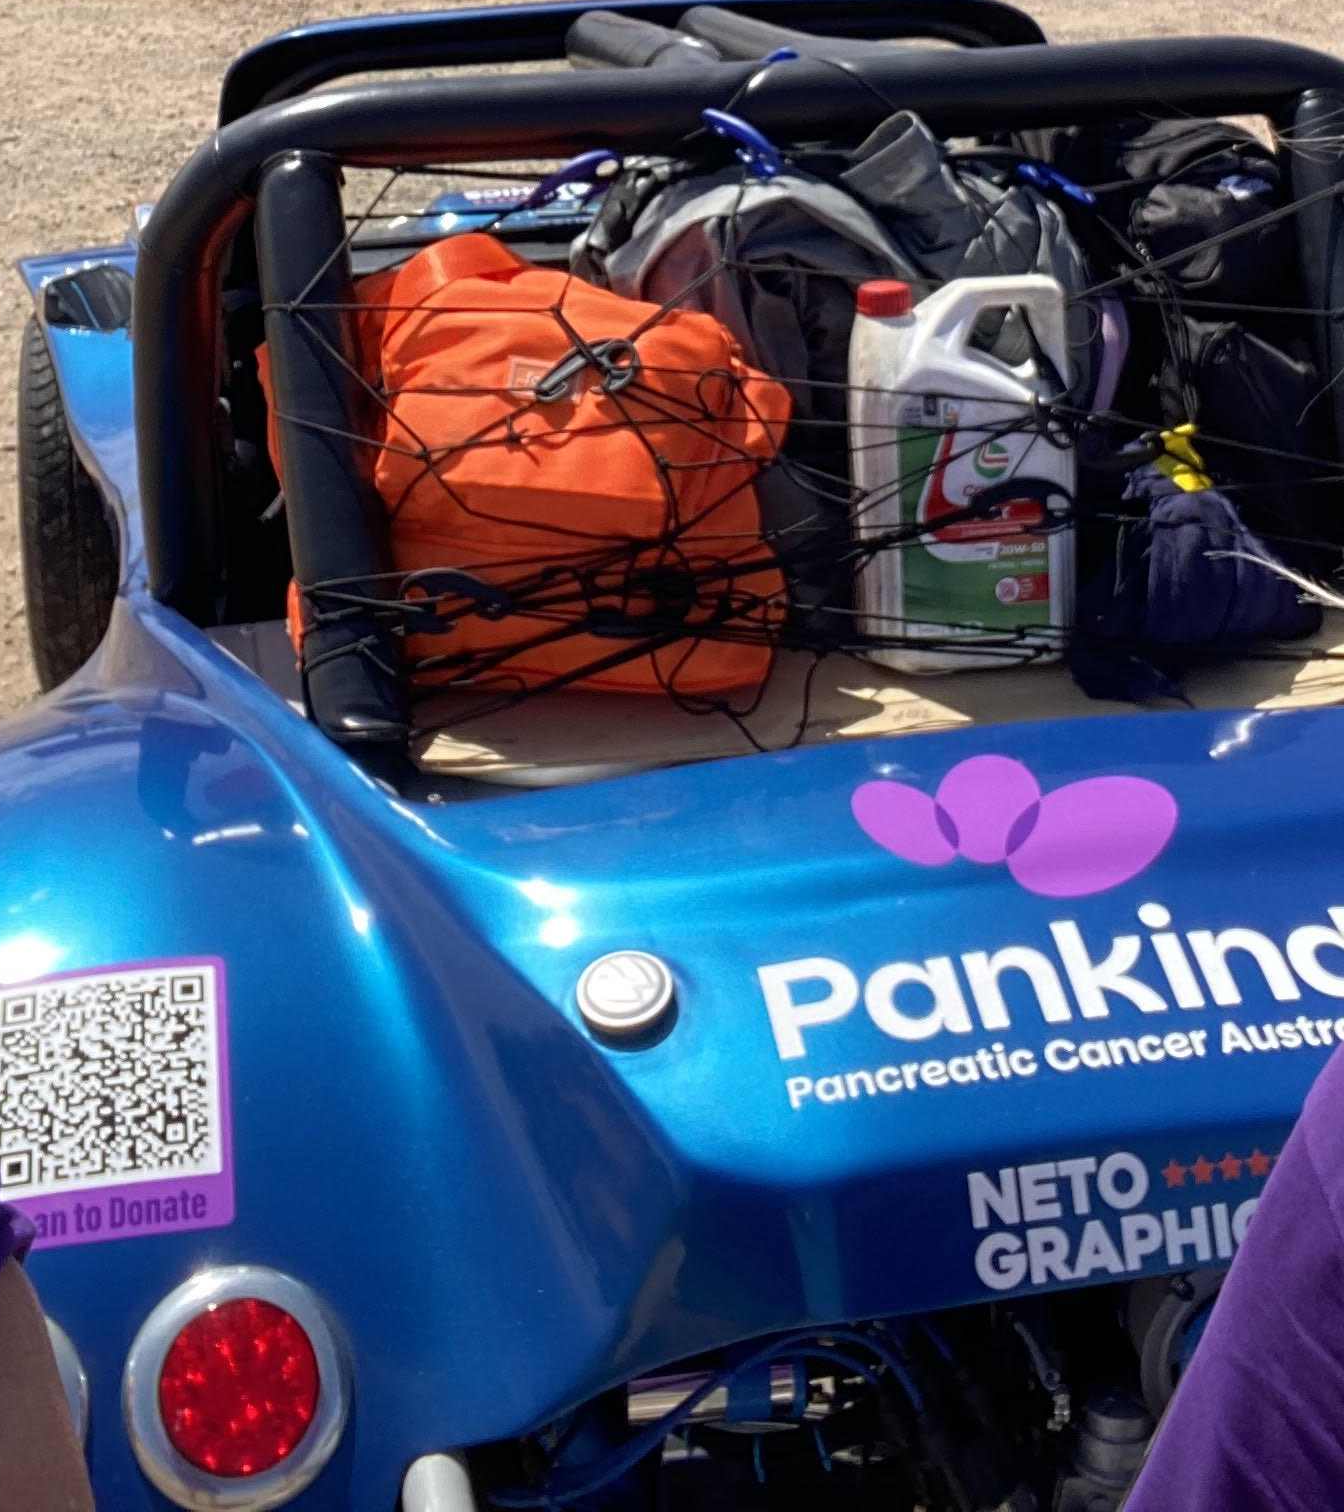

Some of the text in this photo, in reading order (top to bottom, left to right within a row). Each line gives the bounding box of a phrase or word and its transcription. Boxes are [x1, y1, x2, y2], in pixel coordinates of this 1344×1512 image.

[785, 1042, 1037, 1108] Pancreatic
[1043, 1022, 1208, 1074] Cancer
[74, 1201, 102, 1235] to
[109, 1189, 207, 1228] Donate
[966, 1151, 1149, 1229] NETO
